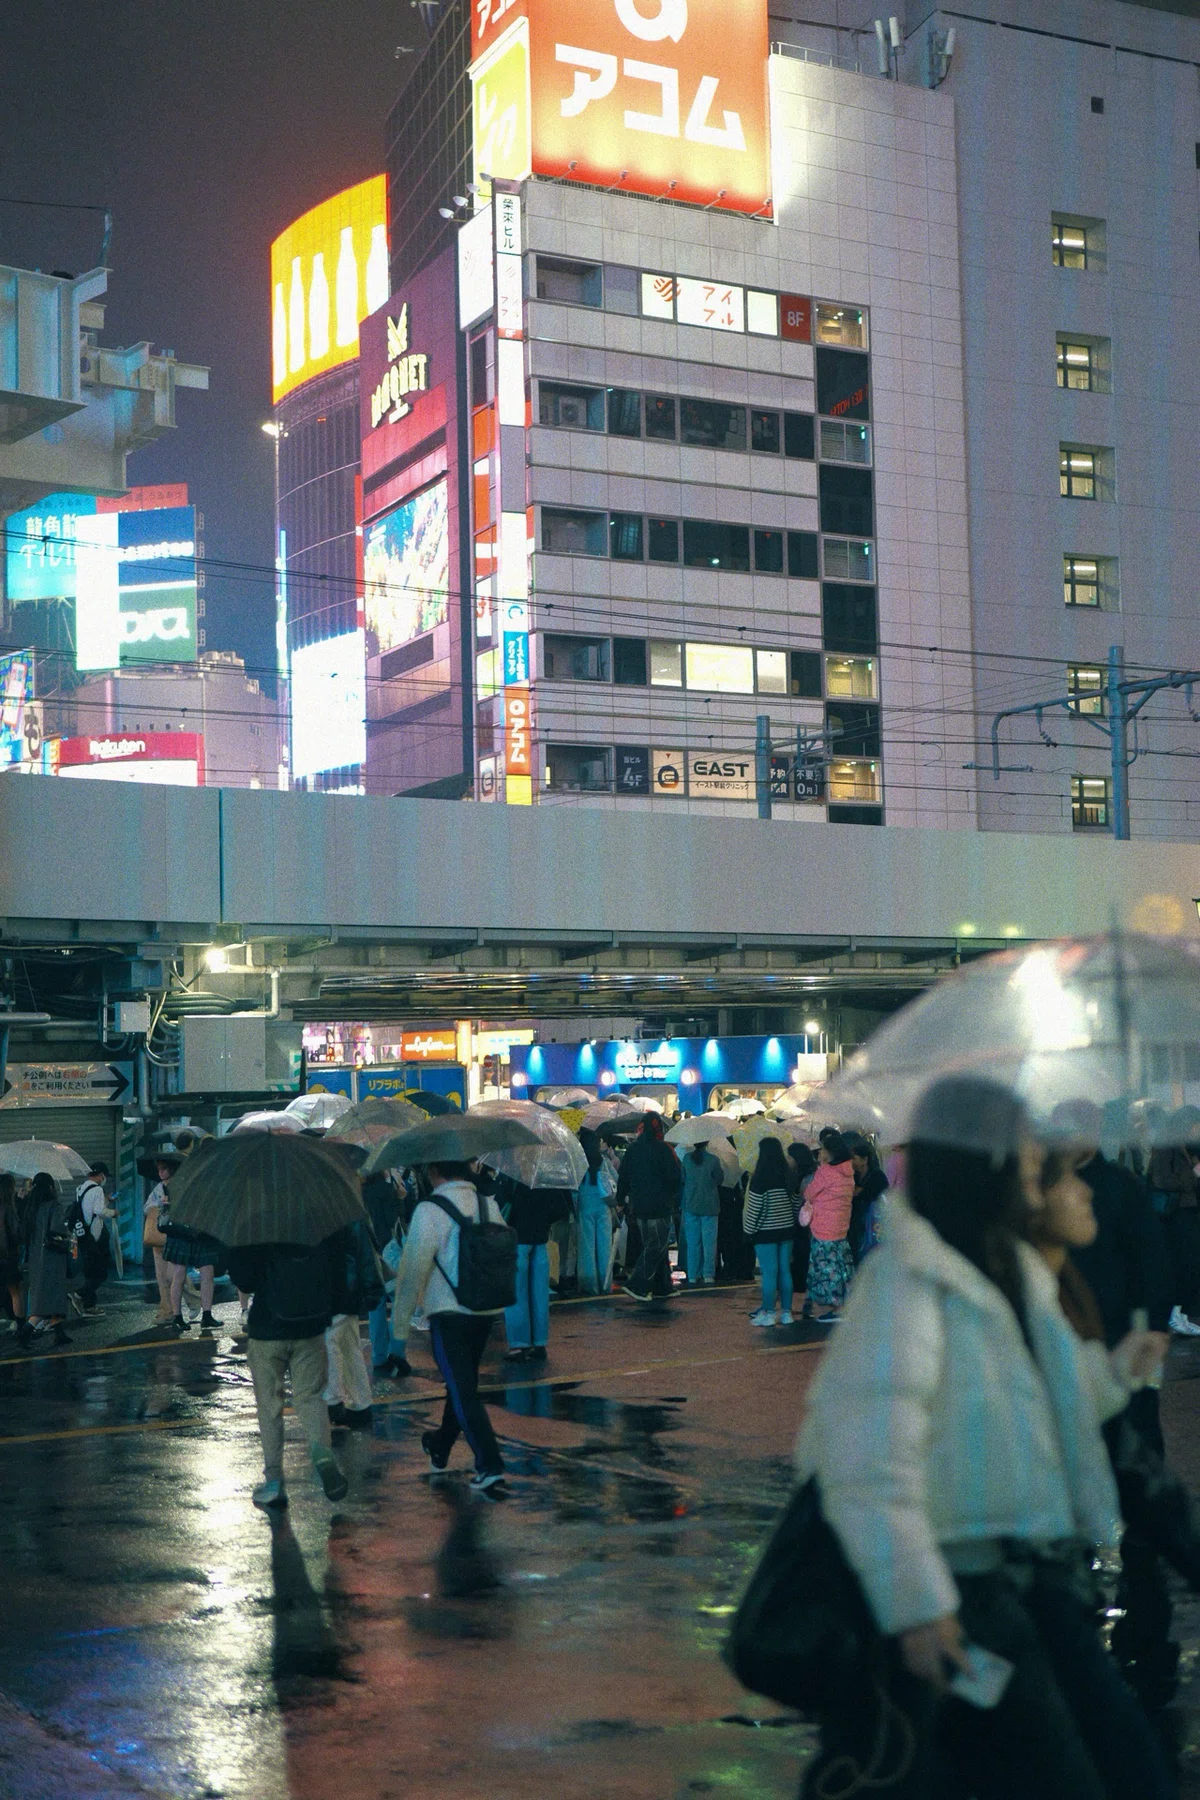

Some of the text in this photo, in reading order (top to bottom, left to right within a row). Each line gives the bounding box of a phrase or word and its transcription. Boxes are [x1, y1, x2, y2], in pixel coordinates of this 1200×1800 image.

[555, 43, 747, 151] アコム
[787, 310, 805, 327] 8F
[89, 738, 146, 756] Rakuten
[510, 717, 526, 763] アコム
[623, 767, 643, 787] 4F
[693, 761, 750, 777] EAST
